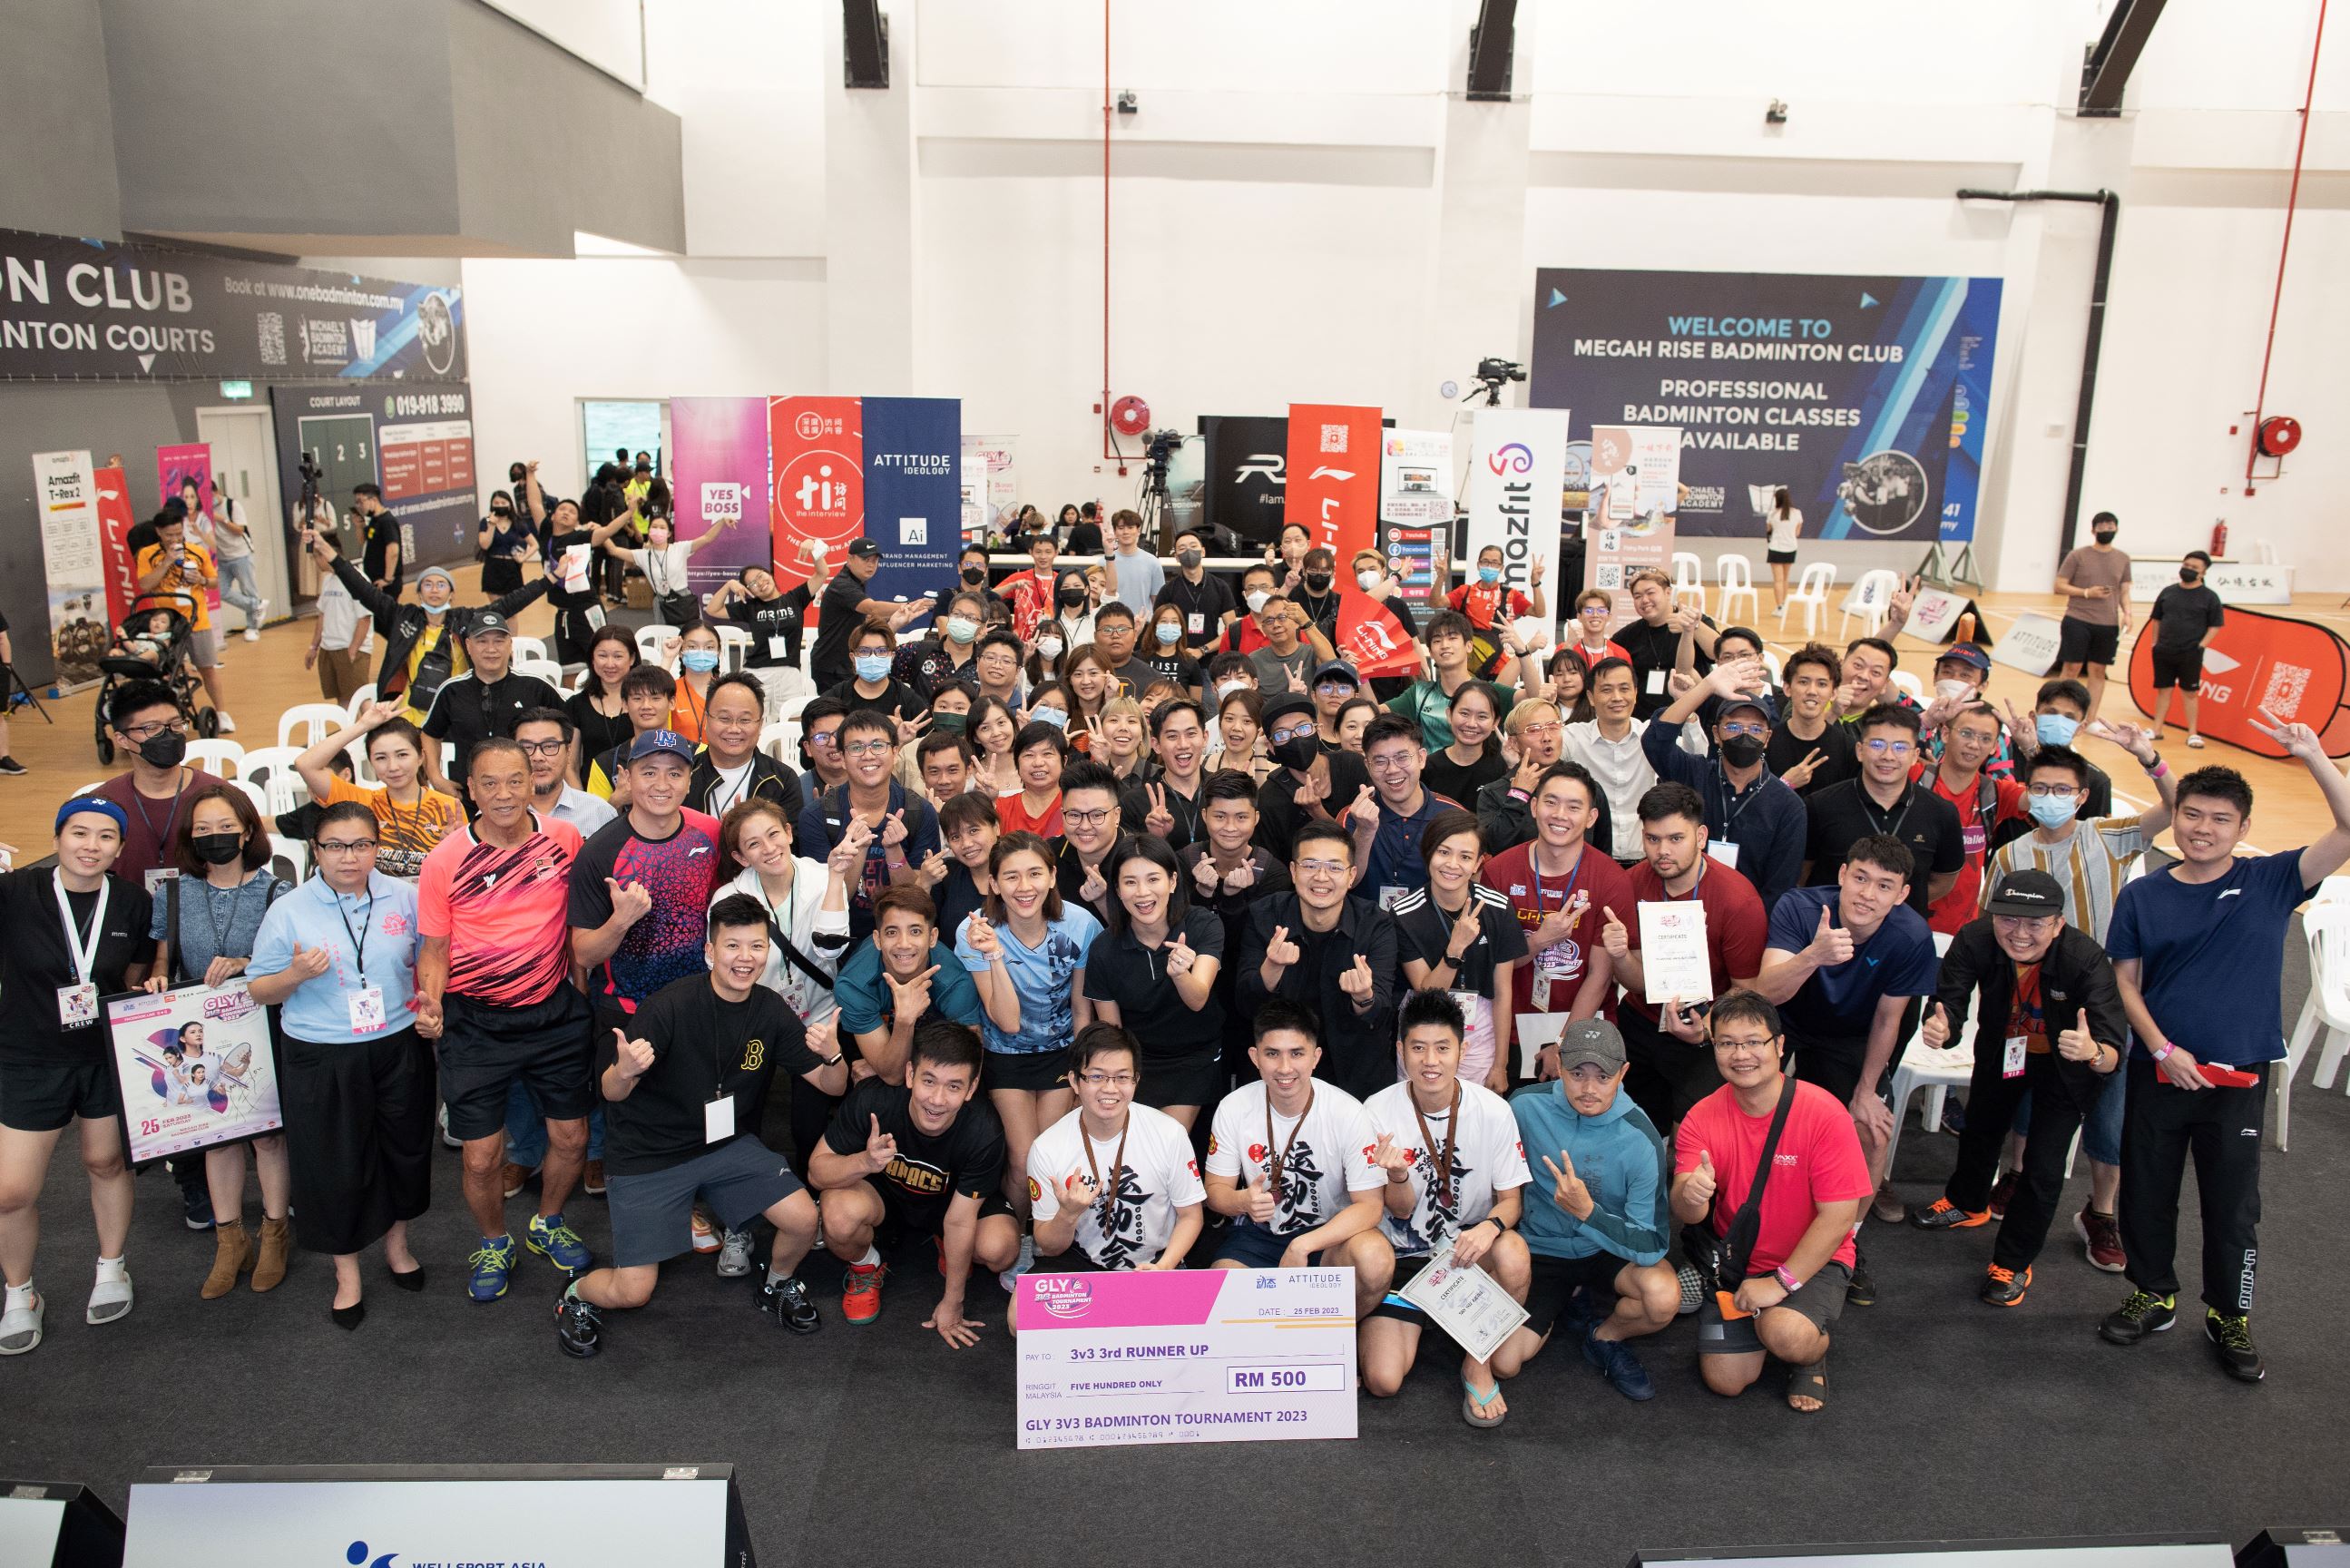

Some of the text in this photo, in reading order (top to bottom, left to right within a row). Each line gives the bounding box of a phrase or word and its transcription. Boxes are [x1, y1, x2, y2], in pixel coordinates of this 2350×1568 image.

[0, 256, 192, 312] N CLUB
[225, 277, 404, 315] Book at www.onebadminton.com.my
[1669, 316, 1832, 339] WELCOME TO
[0, 320, 215, 353] NTON COURTS
[312, 343, 348, 356] ACADEMY
[1573, 338, 1904, 363] MEGAH RISE BADMINTON CLUB
[1660, 380, 1828, 400] PROFESSIONAL
[308, 396, 361, 408] COURT LAYOUT
[397, 394, 465, 416] 019-918 3990
[1623, 404, 1862, 426] BADMINTON CLASSES
[1680, 432, 1800, 452] AVAILABLE
[337, 444, 345, 462] 2
[358, 443, 366, 458] 3
[874, 454, 951, 466] ATTITUDE
[904, 466, 950, 475] IDEOLOGY
[48, 473, 81, 486] Amazfit
[49, 487, 81, 501] T-Rex 2
[710, 489, 733, 500] YES
[704, 503, 739, 514] BOSS
[1680, 499, 1725, 508] ACADEMY
[908, 529, 924, 543] Ai
[1356, 624, 1389, 661] LI-NING
[2011, 631, 2058, 653] ATTITUDE
[2005, 888, 2045, 899] Champion
[204, 994, 237, 1011] GLY
[69, 1018, 93, 1029] CREW
[360, 1024, 379, 1033] VIP
[740, 1040, 764, 1071] B
[141, 1118, 161, 1136] 25
[1034, 1279, 1070, 1293] GLY
[1288, 1274, 1342, 1283] ATTITUDE
[2238, 1249, 2257, 1309] LI-NING
[1440, 1275, 1464, 1300] CERTIFICATE
[1070, 1348, 1095, 1360] 3v3
[1099, 1347, 1121, 1358] 3rd
[1126, 1345, 1185, 1357] RUNNER
[1190, 1345, 1209, 1357] UP
[1092, 1381, 1136, 1389] HUNDRED
[1139, 1380, 1162, 1388] ONLY
[1235, 1370, 1307, 1387] RM 500
[1025, 1410, 1307, 1431] GLY 3V3 BADMINTON TOURNAMENT 2023
